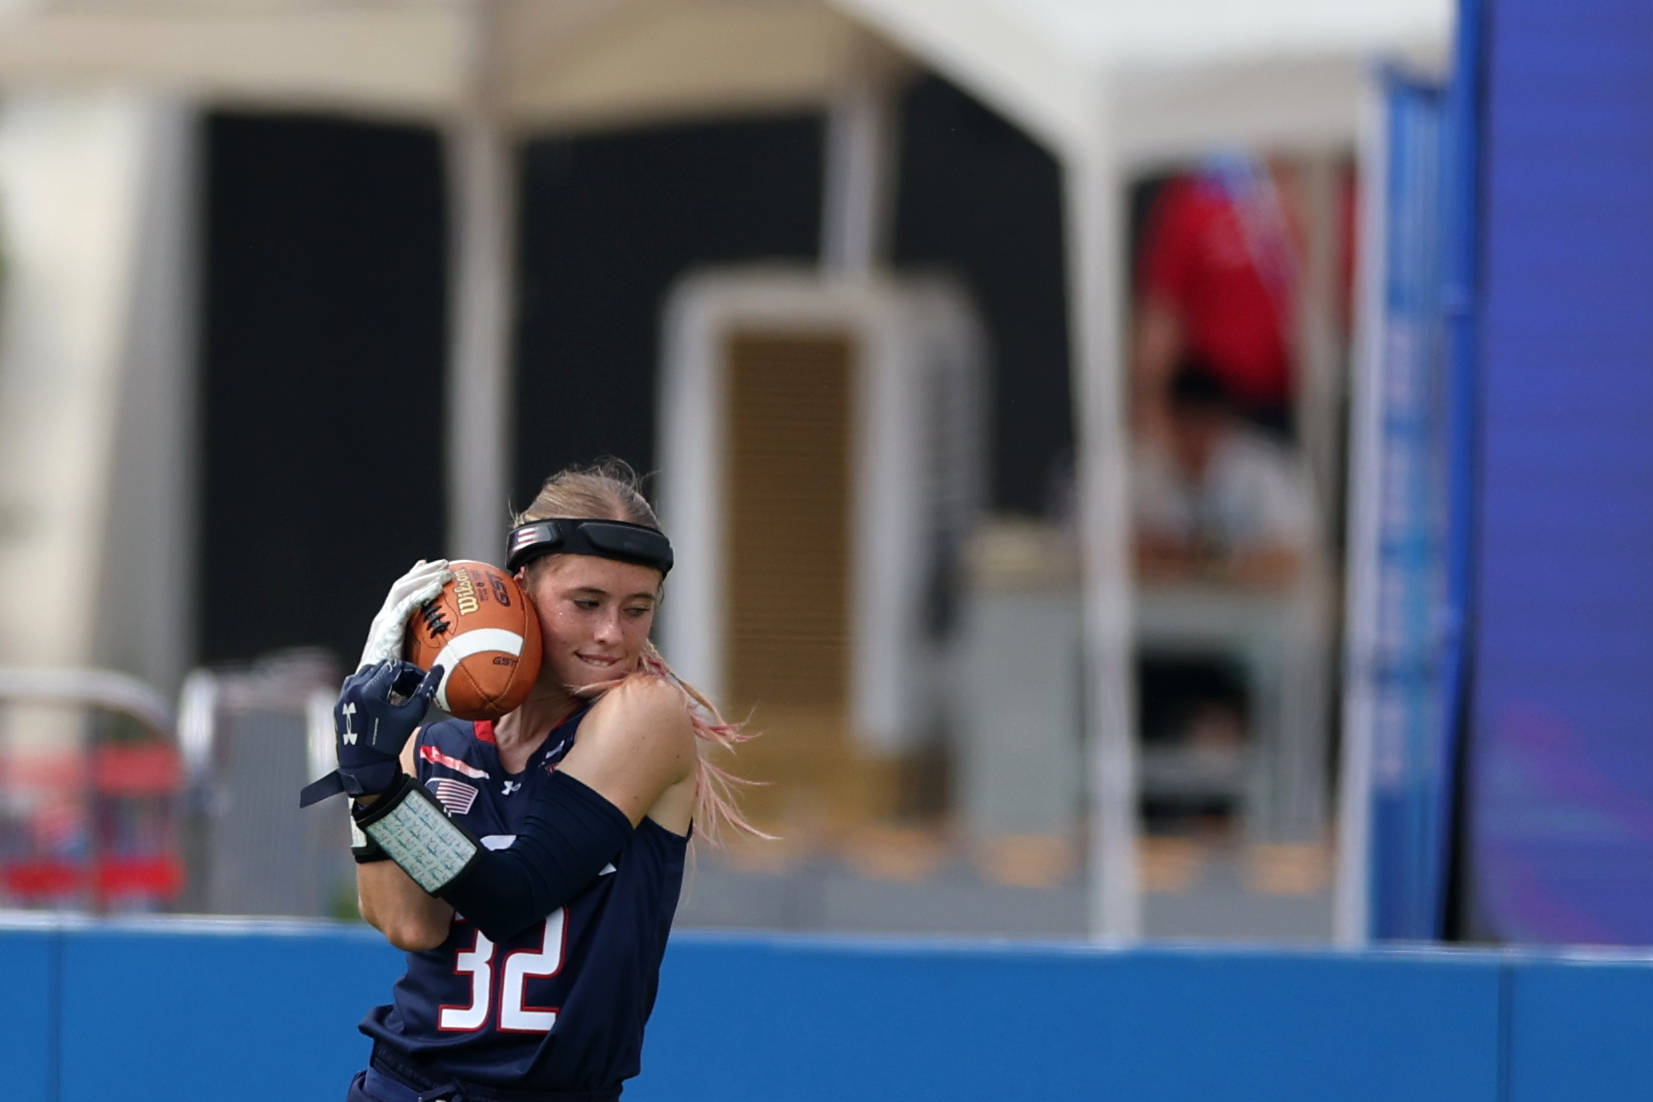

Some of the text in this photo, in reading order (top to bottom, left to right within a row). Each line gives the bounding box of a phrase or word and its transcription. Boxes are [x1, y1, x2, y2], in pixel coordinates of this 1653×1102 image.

[454, 567, 480, 616] Wilson
[493, 656, 518, 667] GST
[438, 904, 569, 1034] 32
